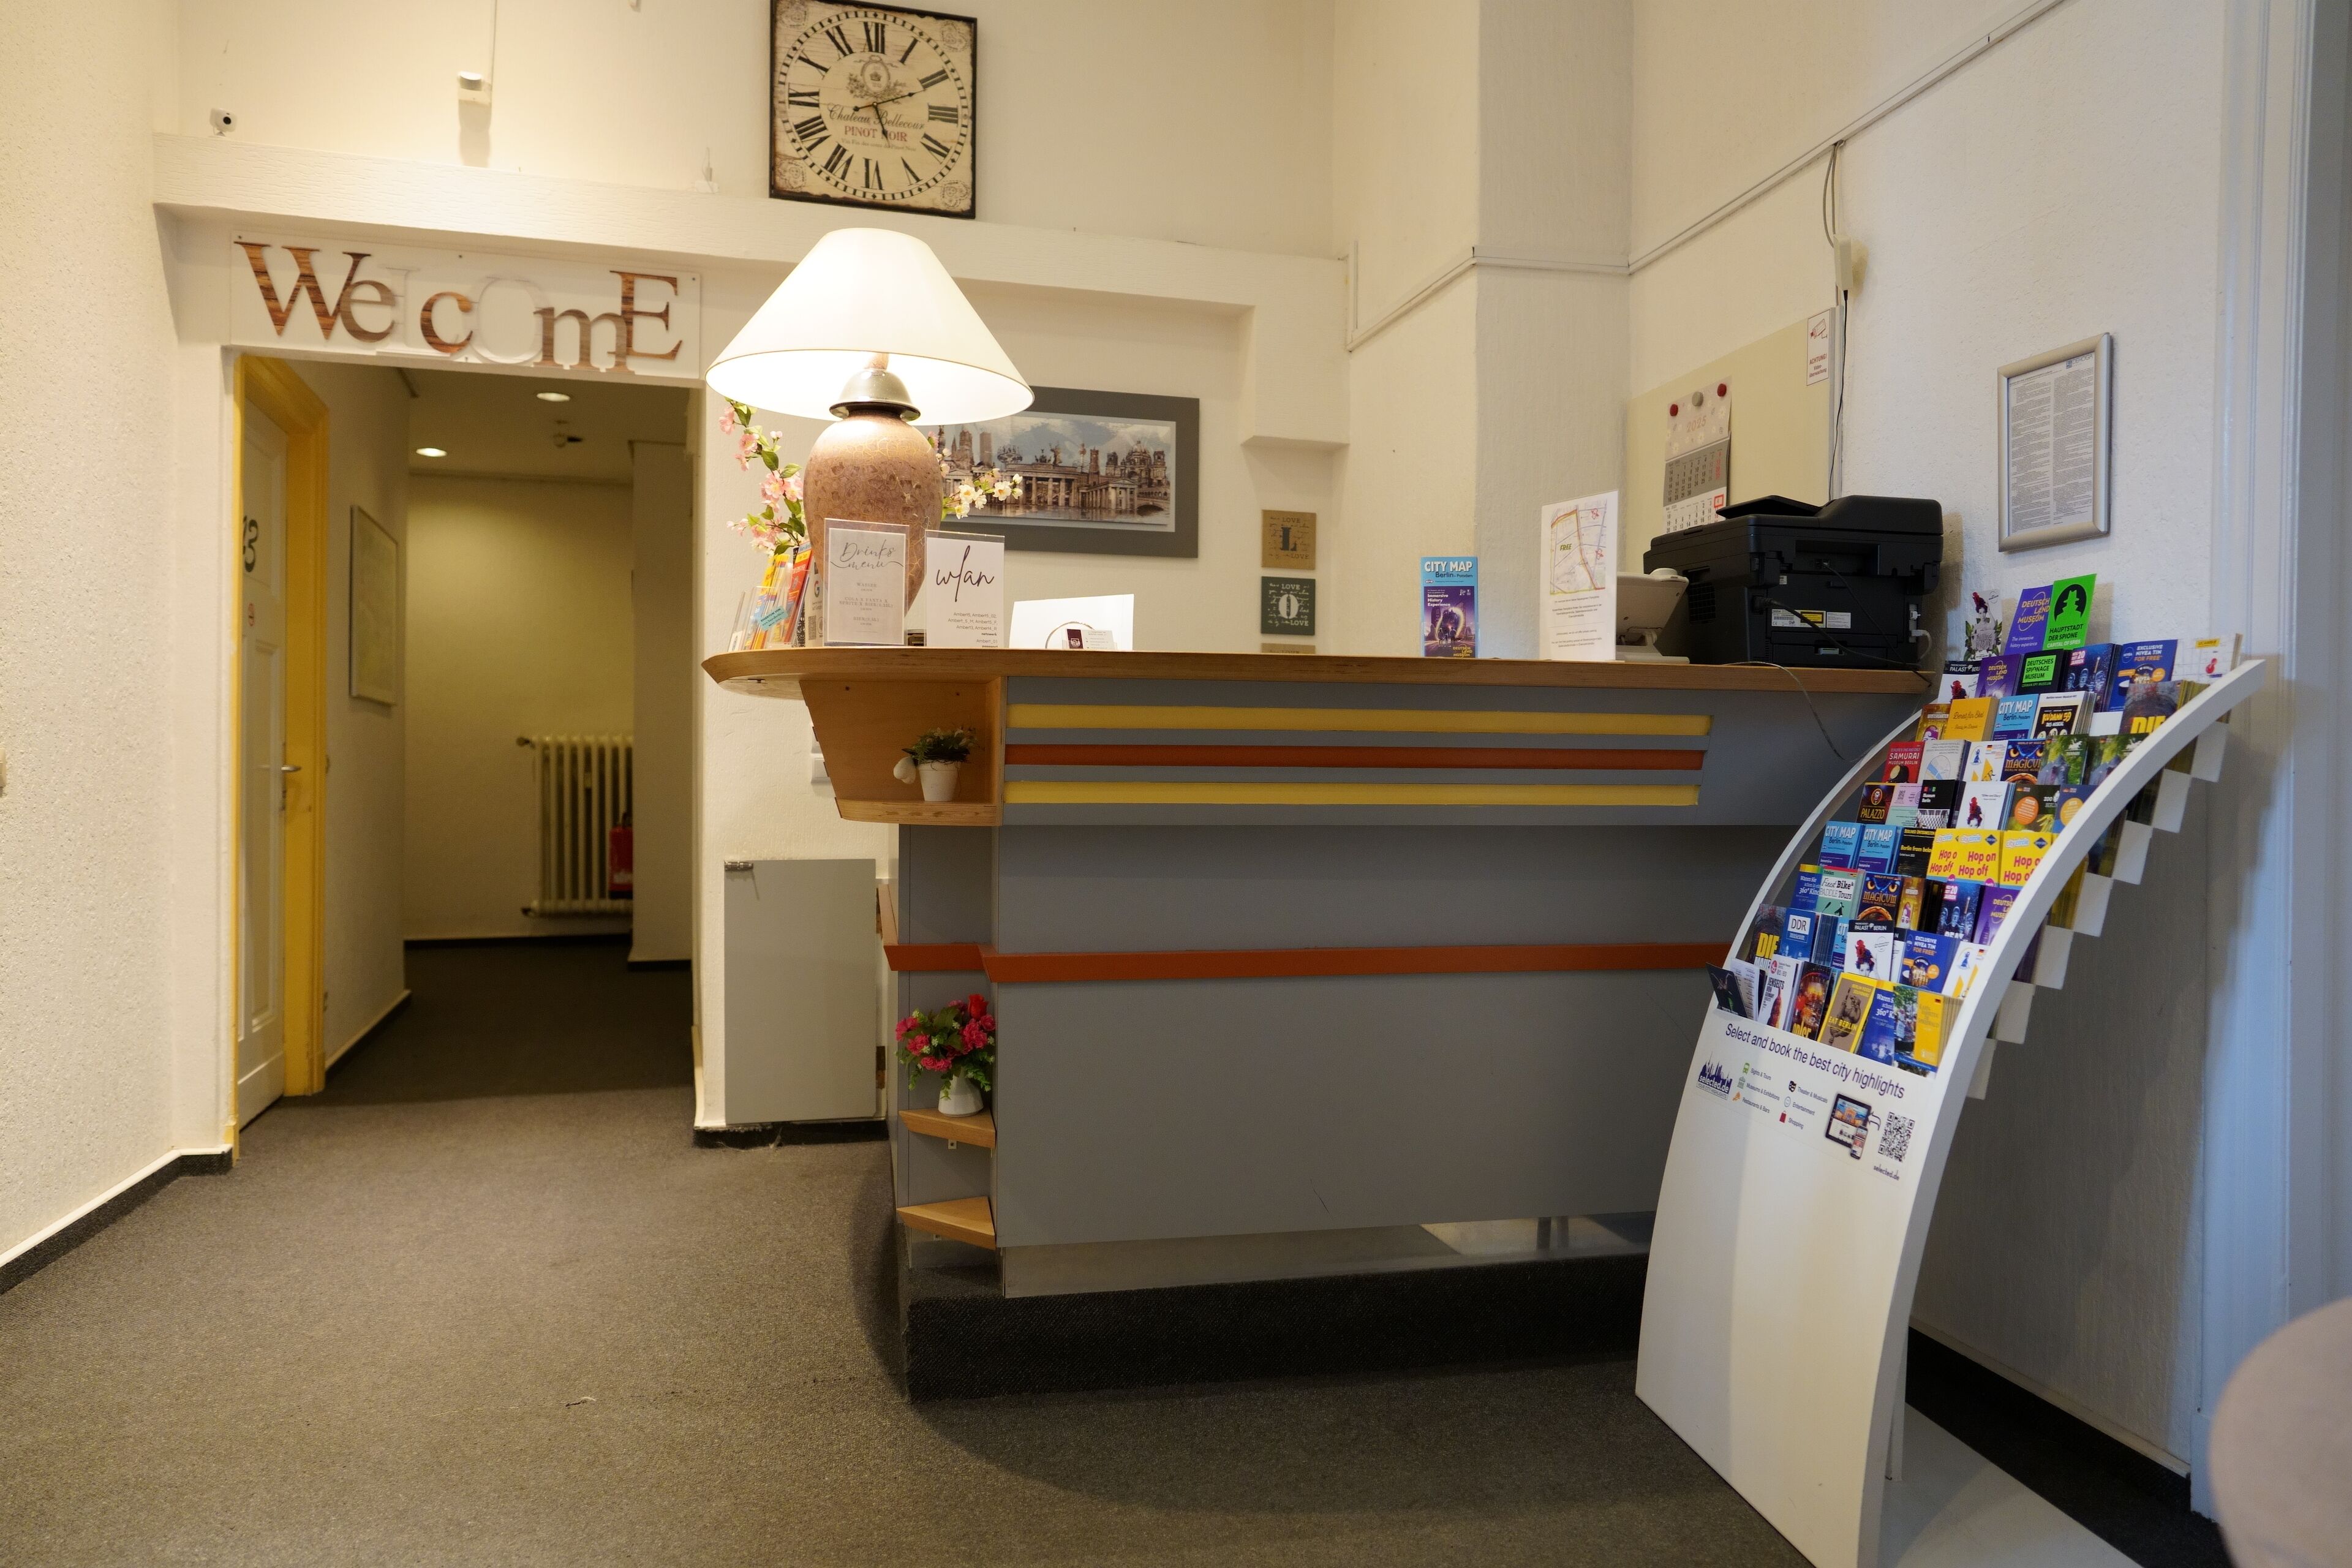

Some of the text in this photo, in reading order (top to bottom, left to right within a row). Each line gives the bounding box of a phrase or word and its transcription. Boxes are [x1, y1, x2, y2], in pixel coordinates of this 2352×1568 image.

[827, 104, 925, 130] Chateau Bellecour
[844, 126, 877, 138] PINOT
[1686, 417, 1707, 432] 2025
[840, 539, 895, 562] Drinks
[1424, 561, 1473, 572] CITY MAP
[936, 545, 994, 602] wlan
[2021, 597, 2051, 608] DEUTSCH
[2034, 605, 2051, 614] LAND
[2017, 614, 2045, 624] MUSEUM
[2049, 624, 2084, 634] HAUPTSTADT
[2078, 650, 2086, 660] 20
[2027, 658, 2054, 666] DEUTSCHES
[2026, 665, 2049, 674] SPIONAGE
[1998, 699, 2033, 716] CITY MAP
[2003, 713, 2017, 722] Berlin
[2062, 711, 2072, 722] 59
[1860, 808, 1885, 820] PALAZZO
[1825, 825, 1856, 839] CITY MAP
[1864, 828, 1877, 841] CITY
[1877, 829, 1893, 842] MAP
[1939, 850, 1951, 860] Hop
[1967, 851, 1997, 864] Hop on
[1929, 862, 1954, 873] Hop off
[2014, 856, 2032, 869] Hop
[1958, 863, 1989, 878] Hop off
[2003, 870, 2022, 884] Hop
[1836, 878, 1851, 889] Bike
[1819, 888, 1852, 900] PADDLE Tours
[1863, 889, 1897, 904] MAGICUM
[1791, 919, 1806, 932] DDR
[1755, 932, 1780, 960] DIE
[1915, 935, 1937, 944] EXCLUSIVE
[1876, 993, 1891, 1003] Waren
[1828, 1016, 1858, 1031] EAT BERLIN
[1725, 1022, 1905, 1099] Select and book the best city highlights
[1699, 1075, 1730, 1093] selected.de
[1746, 1082, 1781, 1101] Museums Exhibitions
[1798, 1087, 1828, 1104] Theater Musicals
[1742, 1097, 1760, 1109] Restaurants
[1792, 1102, 1815, 1116] Entertainment
[1788, 1117, 1804, 1130] Shopping
[1873, 1164, 1900, 1181] selected.de
